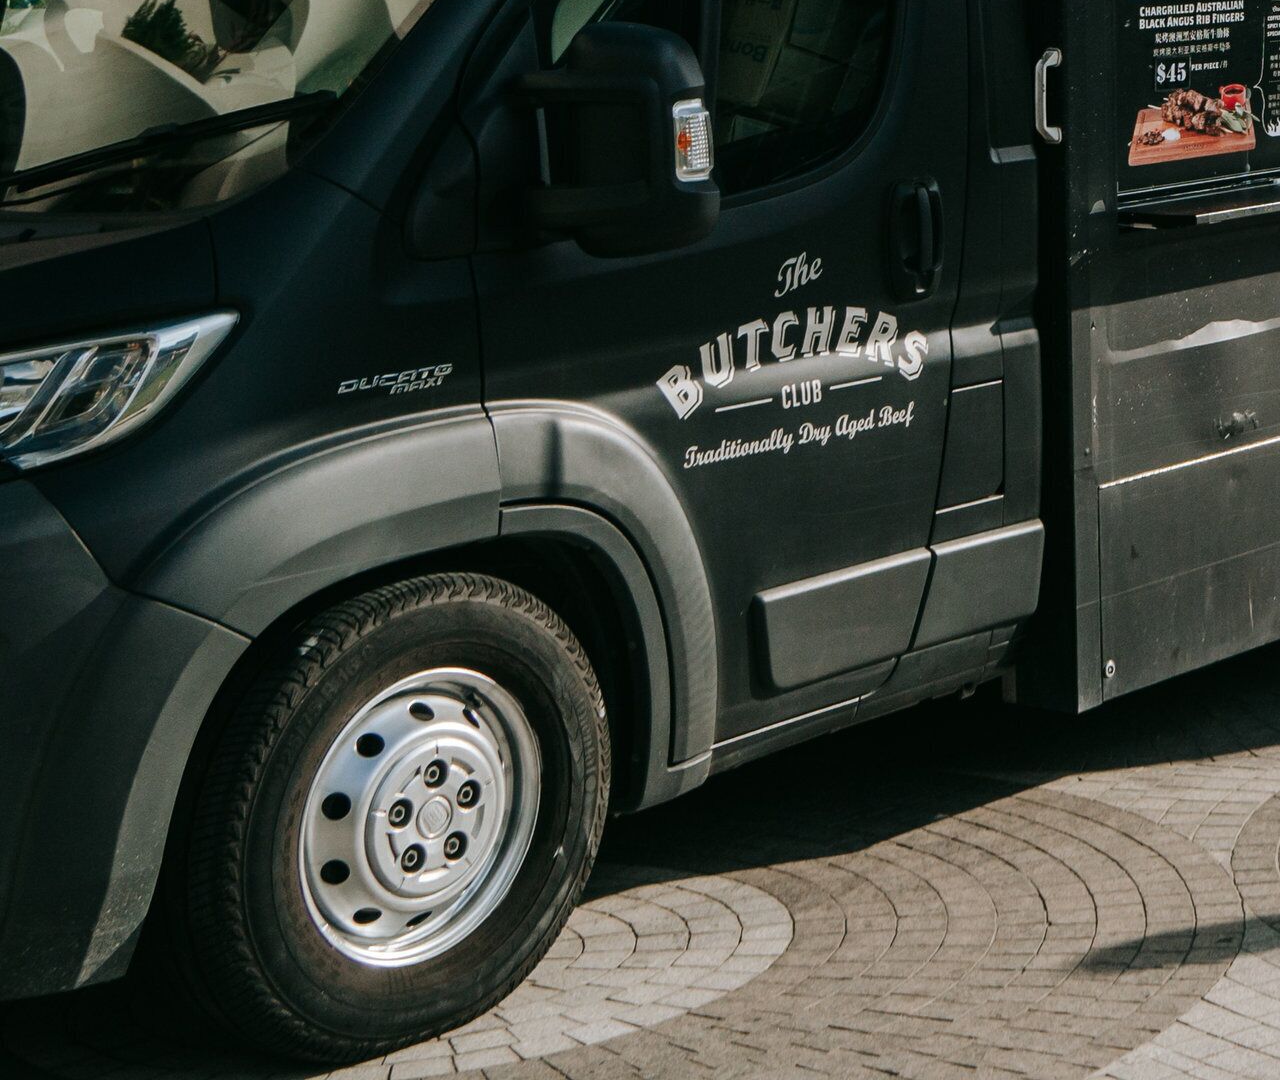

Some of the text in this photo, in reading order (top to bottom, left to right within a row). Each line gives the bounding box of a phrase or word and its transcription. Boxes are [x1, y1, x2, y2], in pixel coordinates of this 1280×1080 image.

[1139, 12, 1245, 30] BLACK ANGUS RIB FINGERS
[1140, 0, 1244, 17] CHARGRILLED AUSTRALIAN
[1156, 62, 1187, 84] $45
[1191, 63, 1202, 71] PER
[1203, 62, 1219, 70] PIECE
[774, 251, 823, 298] The
[656, 305, 929, 421] BUTCHERS
[337, 363, 454, 395] DUCATO
[389, 375, 445, 395] MAXI
[781, 379, 823, 410] CLUB
[683, 400, 915, 469] Traditionally Dry Aged Beef
